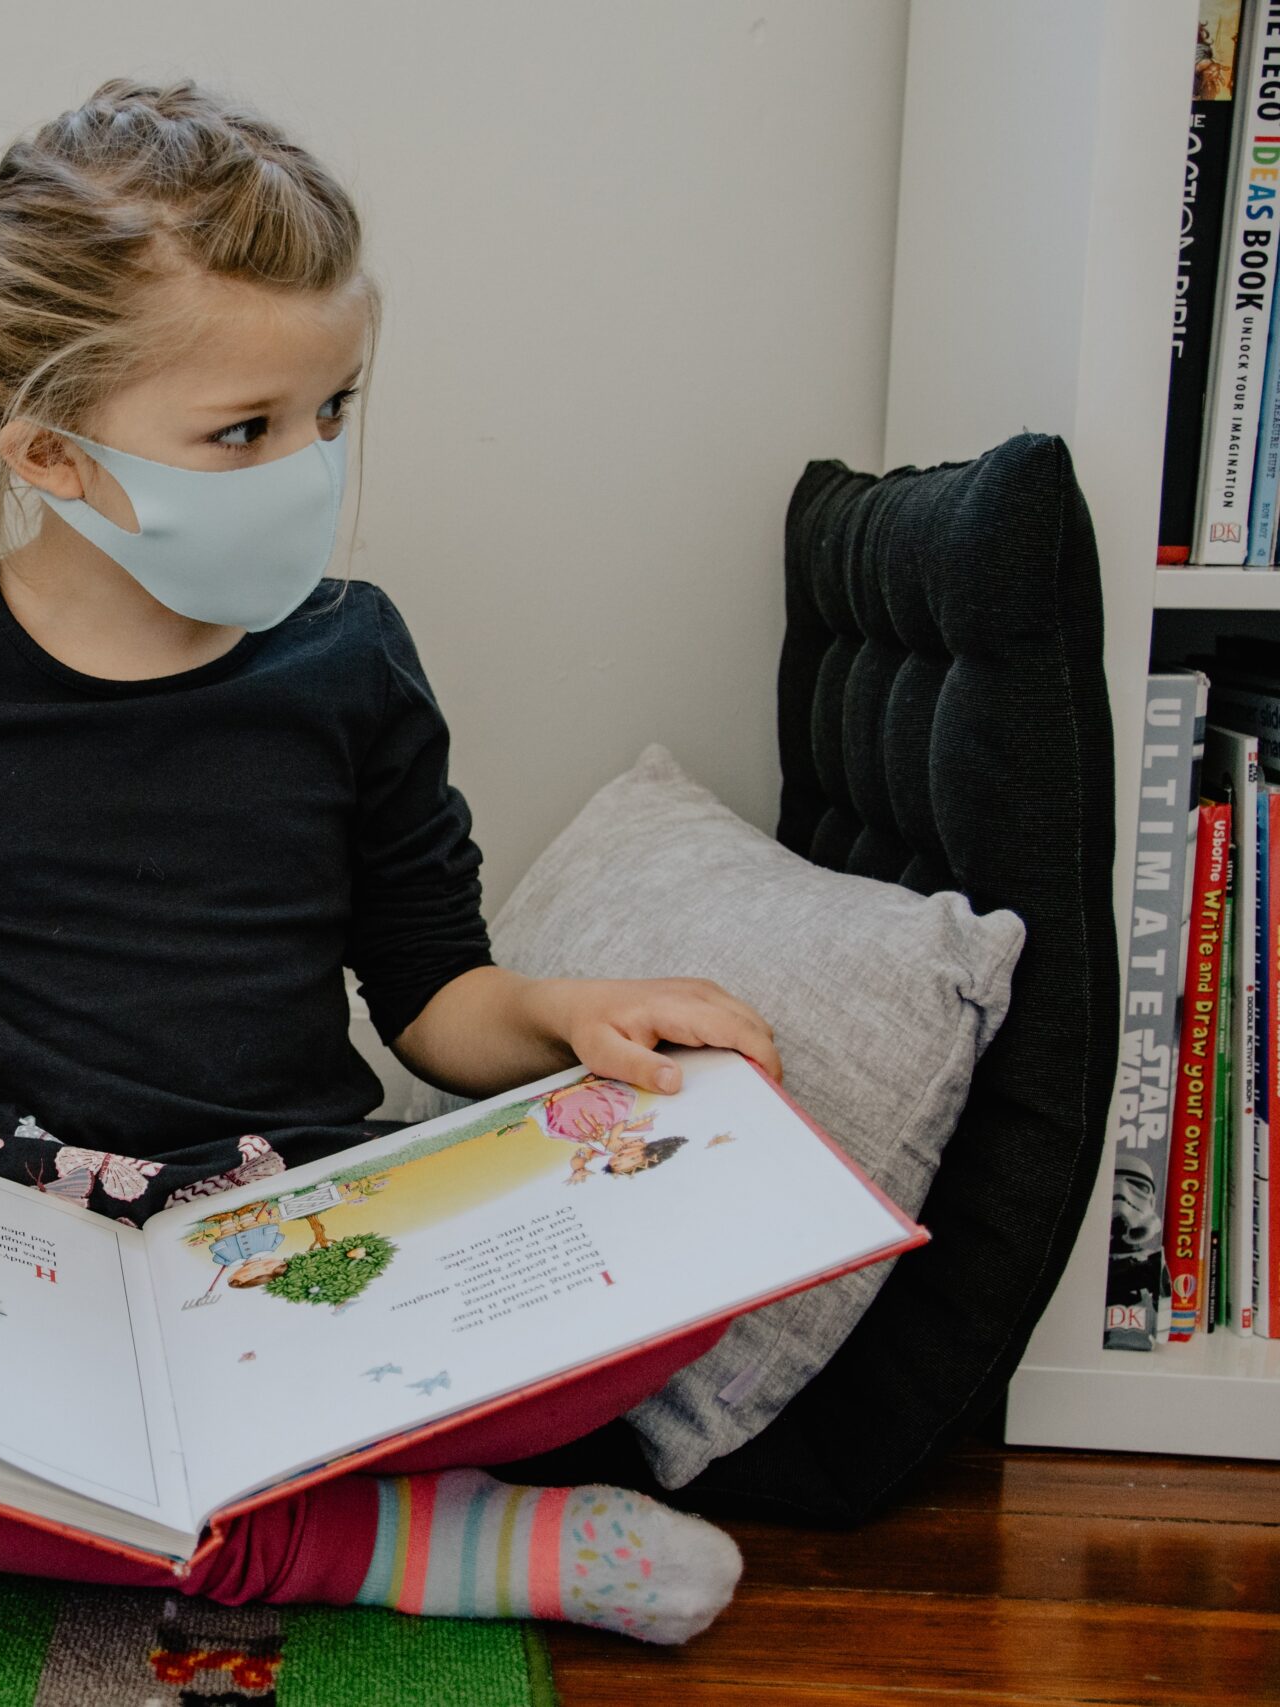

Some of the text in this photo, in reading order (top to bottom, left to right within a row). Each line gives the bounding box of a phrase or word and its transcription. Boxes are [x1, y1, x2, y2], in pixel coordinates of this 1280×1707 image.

[1257, 47, 1280, 121] LEGO
[1246, 136, 1280, 220] IDEAS
[1235, 230, 1271, 311] BOOK
[1223, 317, 1253, 508] UNLOCK YOUR IMAGINATION
[1212, 523, 1239, 540] DK
[1128, 699, 1182, 1016] ULTIMATE
[1176, 889, 1222, 1259] Write and Draw your own Comics
[1139, 1029, 1168, 1149] STAR
[555, 1206, 572, 1216] Of
[531, 1214, 549, 1225] my
[496, 1225, 525, 1238] little
[544, 1224, 582, 1240] Came
[562, 1232, 588, 1244] The
[30, 1234, 55, 1248] And
[444, 1214, 576, 1270] And all for the sake
[470, 1238, 491, 1250] nut
[526, 1240, 539, 1248] to
[565, 1241, 592, 1256] And
[38, 1246, 56, 1257] He
[494, 1248, 521, 1261] visit
[524, 1242, 558, 1260] King
[576, 1250, 599, 1262] But
[500, 1258, 546, 1280] golden
[507, 1259, 520, 1269] of
[549, 1260, 605, 1284] Nothing
[522, 1266, 557, 1284] silver
[599, 1270, 616, 1287] I
[566, 1276, 594, 1291] had
[502, 1284, 544, 1304] would
[518, 1294, 548, 1308] little
[488, 1308, 511, 1320] nut
[1109, 1307, 1143, 1328] DK
